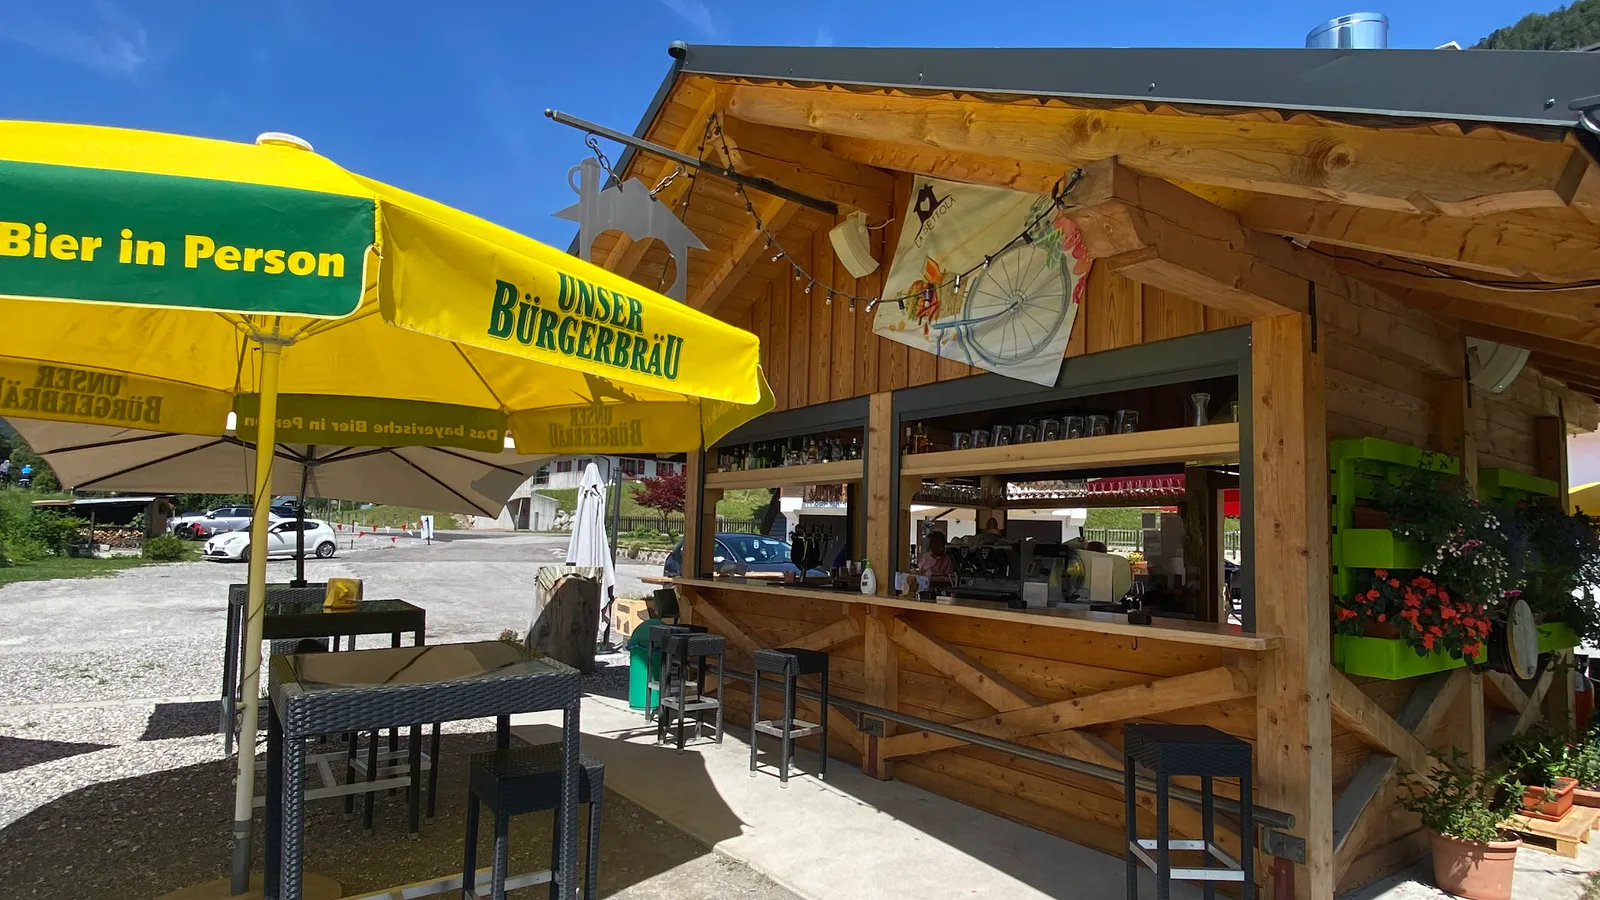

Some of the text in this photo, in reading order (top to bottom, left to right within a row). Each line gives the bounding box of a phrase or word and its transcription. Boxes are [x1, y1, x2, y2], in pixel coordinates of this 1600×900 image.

[0, 221, 345, 278] Bier in Person
[557, 271, 644, 334] UNSER
